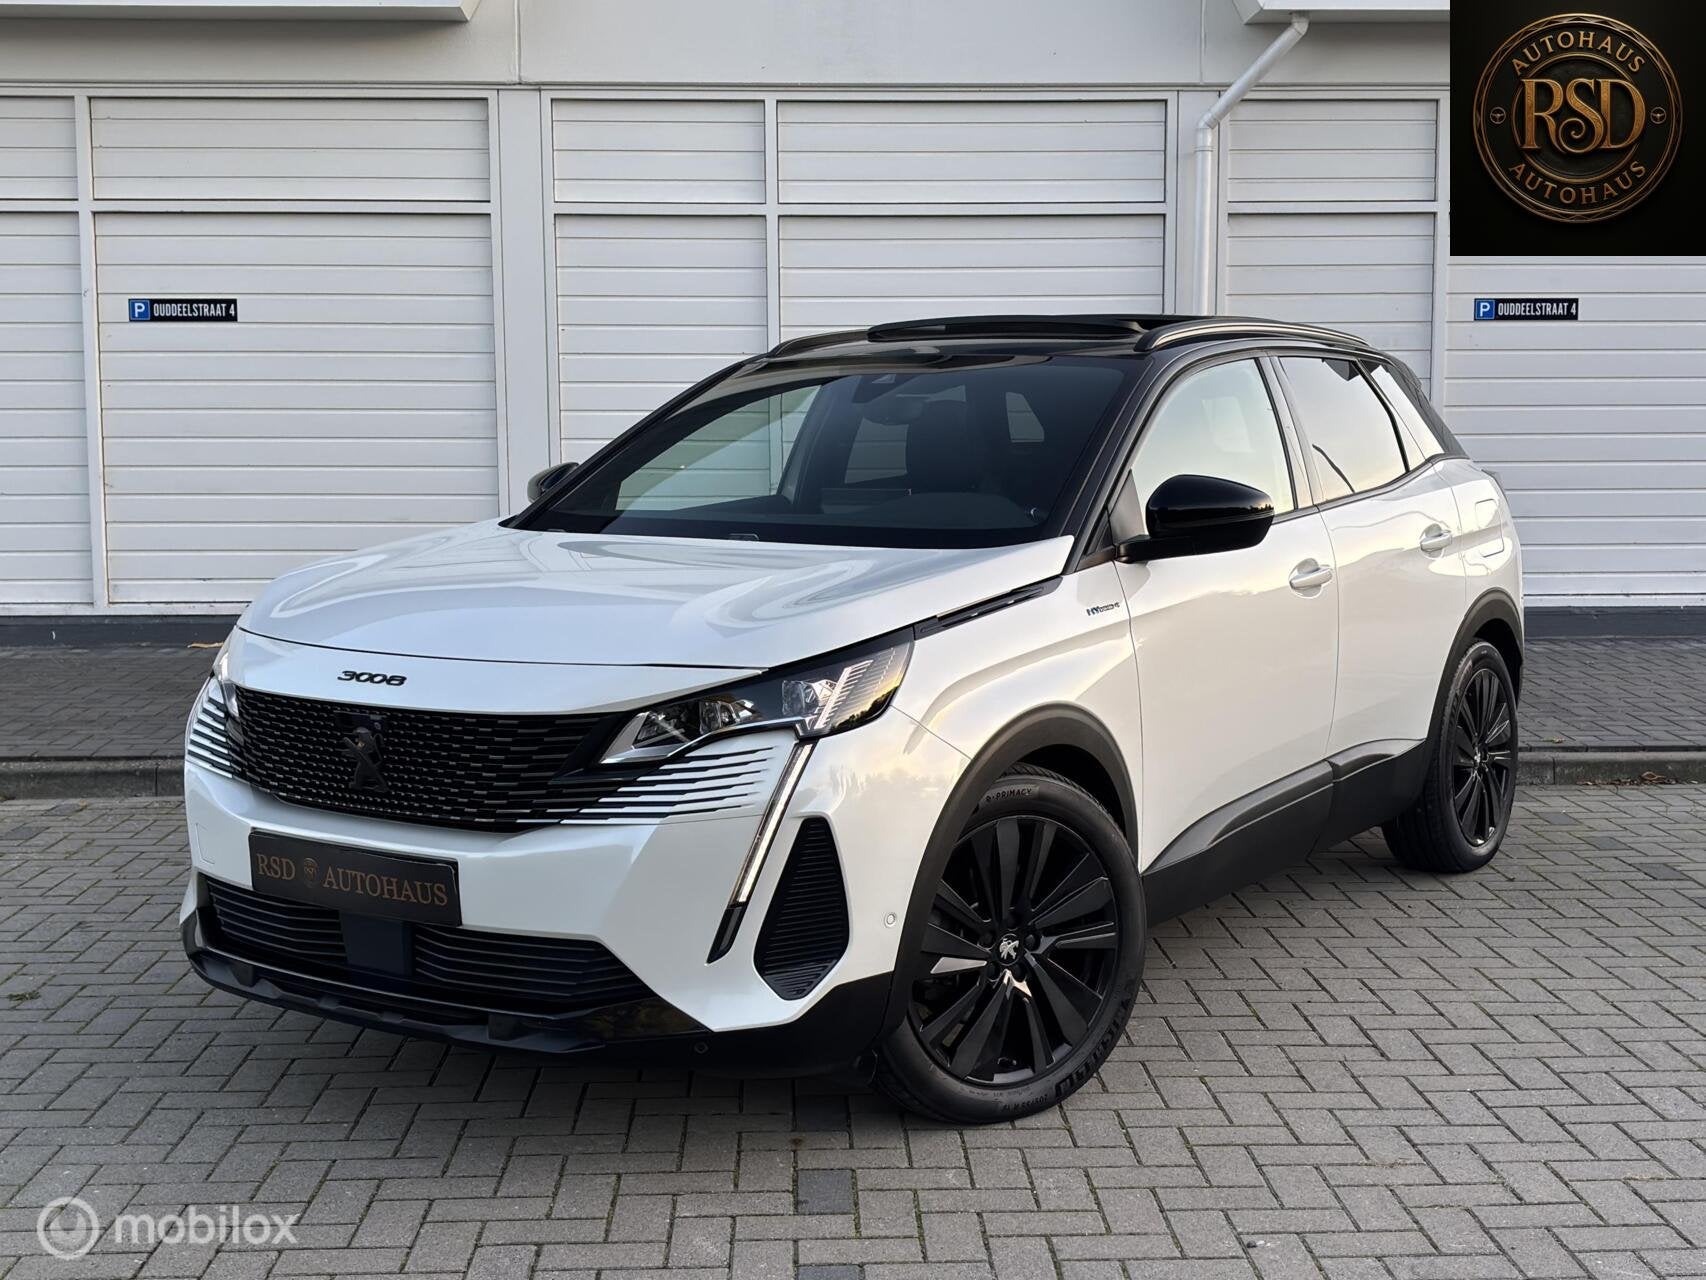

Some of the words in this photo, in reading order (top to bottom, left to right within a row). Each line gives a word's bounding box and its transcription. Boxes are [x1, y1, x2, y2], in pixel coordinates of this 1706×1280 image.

[134, 302, 146, 318] P
[153, 303, 227, 317] OUDDEELSTRAAT
[229, 303, 236, 317] 4
[1479, 302, 1491, 317] P
[1497, 302, 1569, 316] OUDDEELSTRAAT
[1570, 302, 1577, 316] 4
[337, 670, 408, 687] 3008
[256, 853, 296, 881] RSD
[322, 866, 448, 906] AUTOHAUS
